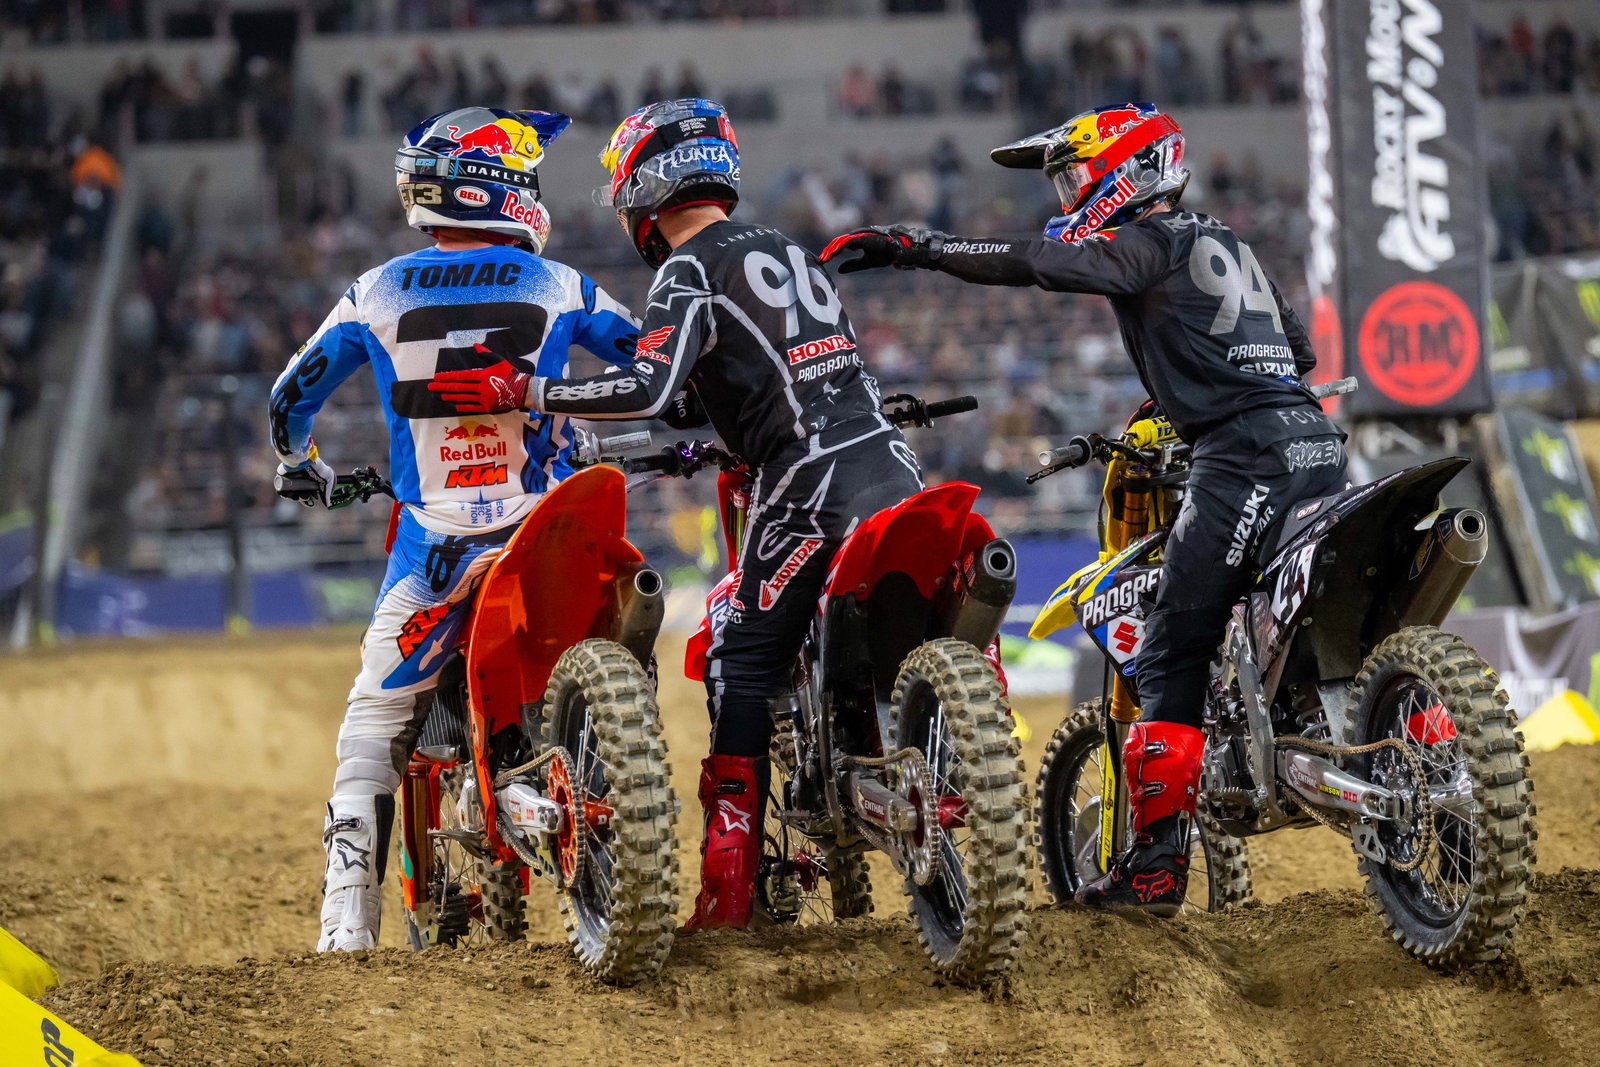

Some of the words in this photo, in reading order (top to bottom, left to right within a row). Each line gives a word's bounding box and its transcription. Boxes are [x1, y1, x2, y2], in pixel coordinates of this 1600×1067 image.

[466, 165, 531, 184] OAKLEY
[459, 189, 486, 203] BELL
[501, 191, 537, 226] Red
[1093, 175, 1138, 220] Bull
[400, 262, 522, 291] TOMAC
[1189, 235, 1285, 336] 94
[744, 244, 842, 339] 96
[1239, 362, 1298, 377] SUZUK
[546, 376, 637, 401] astars
[1277, 410, 1323, 426] FOX
[440, 444, 474, 462] Red
[475, 440, 507, 459] Bull
[444, 461, 508, 488] KTM
[1225, 484, 1270, 568] SUZUKI
[770, 538, 820, 593] HONDA
